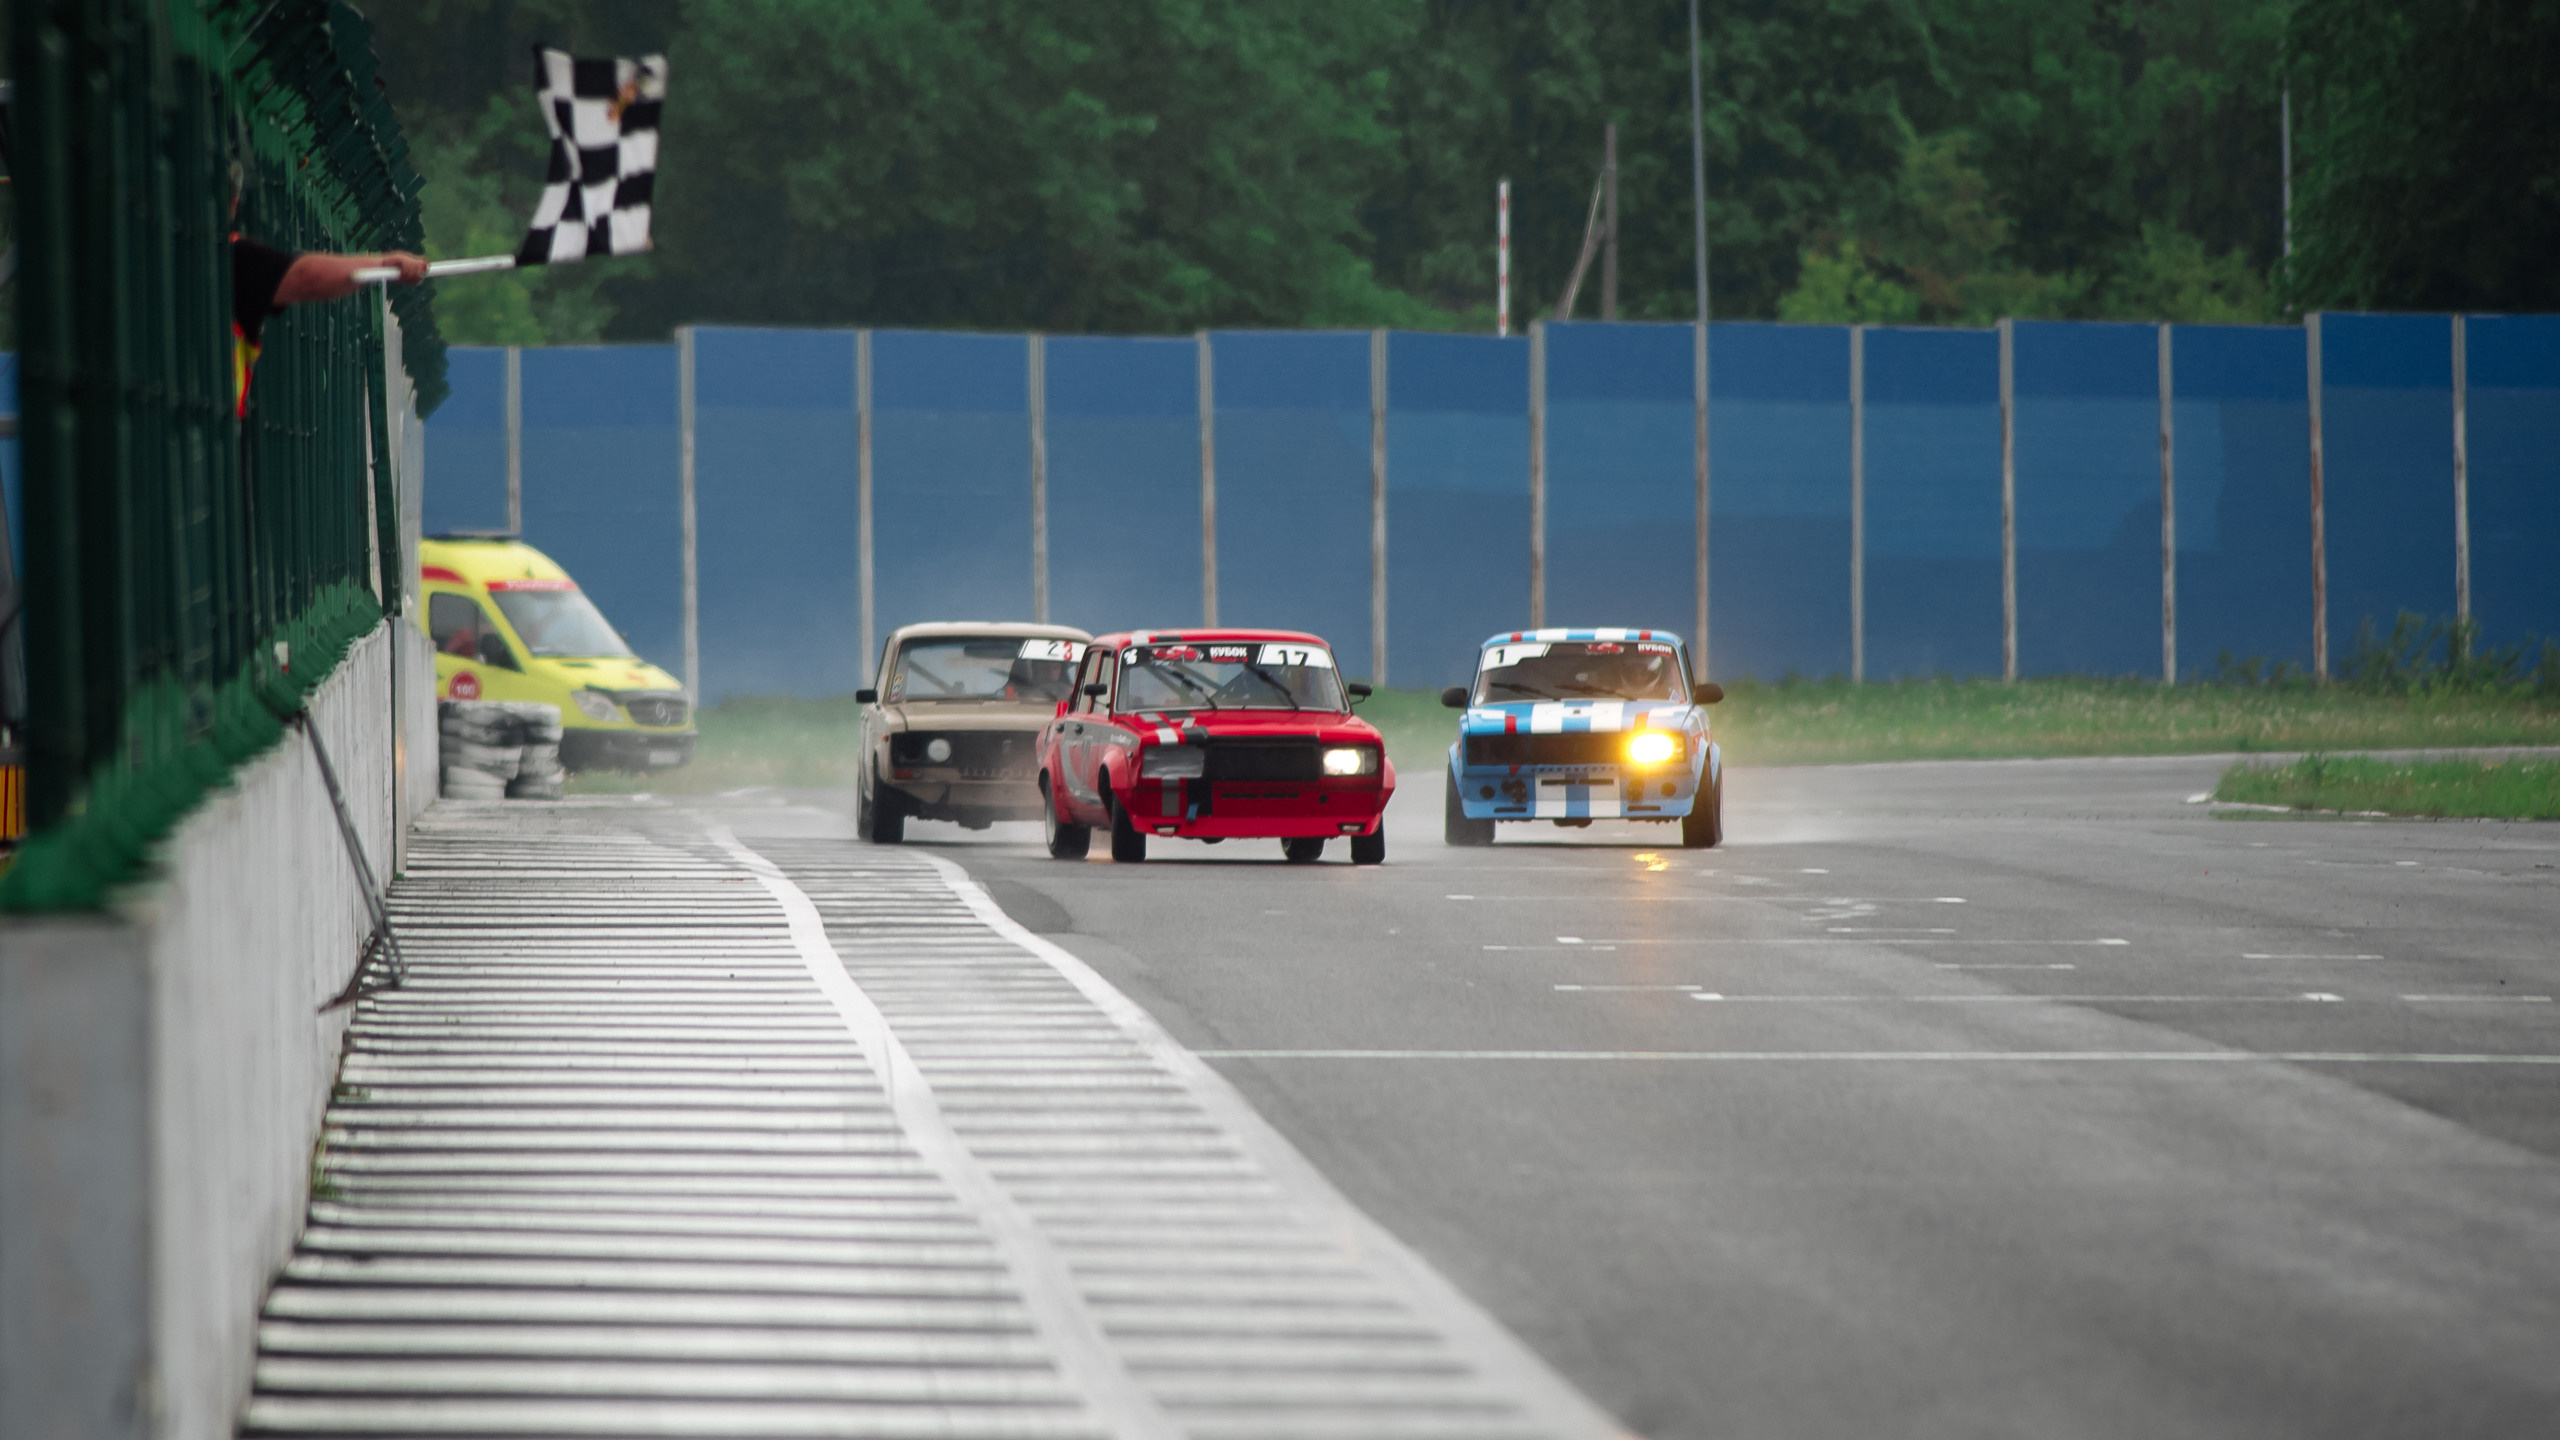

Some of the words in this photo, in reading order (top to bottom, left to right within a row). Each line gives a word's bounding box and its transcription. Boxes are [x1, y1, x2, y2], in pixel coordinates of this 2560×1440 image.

[1047, 639, 1073, 661] 23
[1209, 646, 1248, 658] КУБОК
[1277, 649, 1309, 666] 17
[1495, 648, 1505, 664] 1
